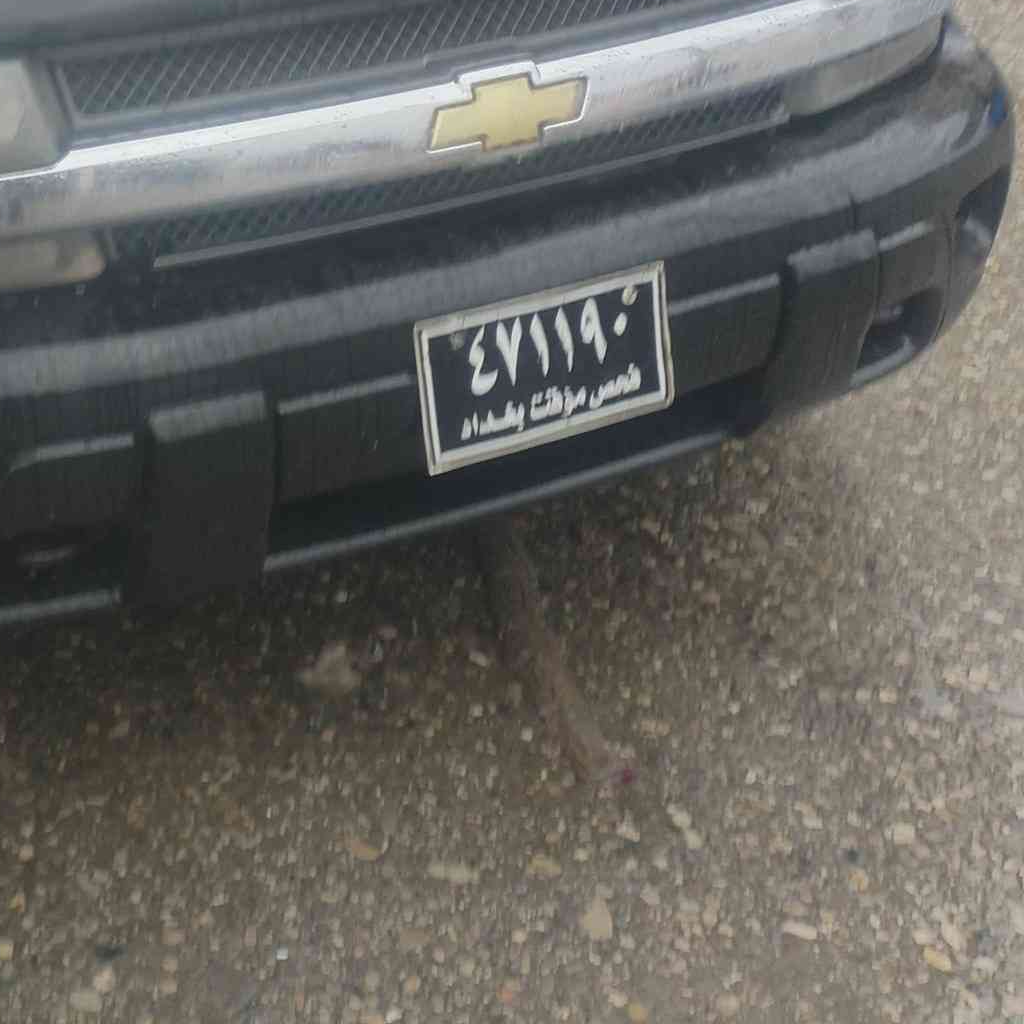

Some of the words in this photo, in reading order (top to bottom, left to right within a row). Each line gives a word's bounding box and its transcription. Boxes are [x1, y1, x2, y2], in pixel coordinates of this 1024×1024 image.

[469, 297, 628, 396] ٤٧١١٩٠
[589, 362, 642, 409] فحص
[460, 400, 526, 441] بغداد
